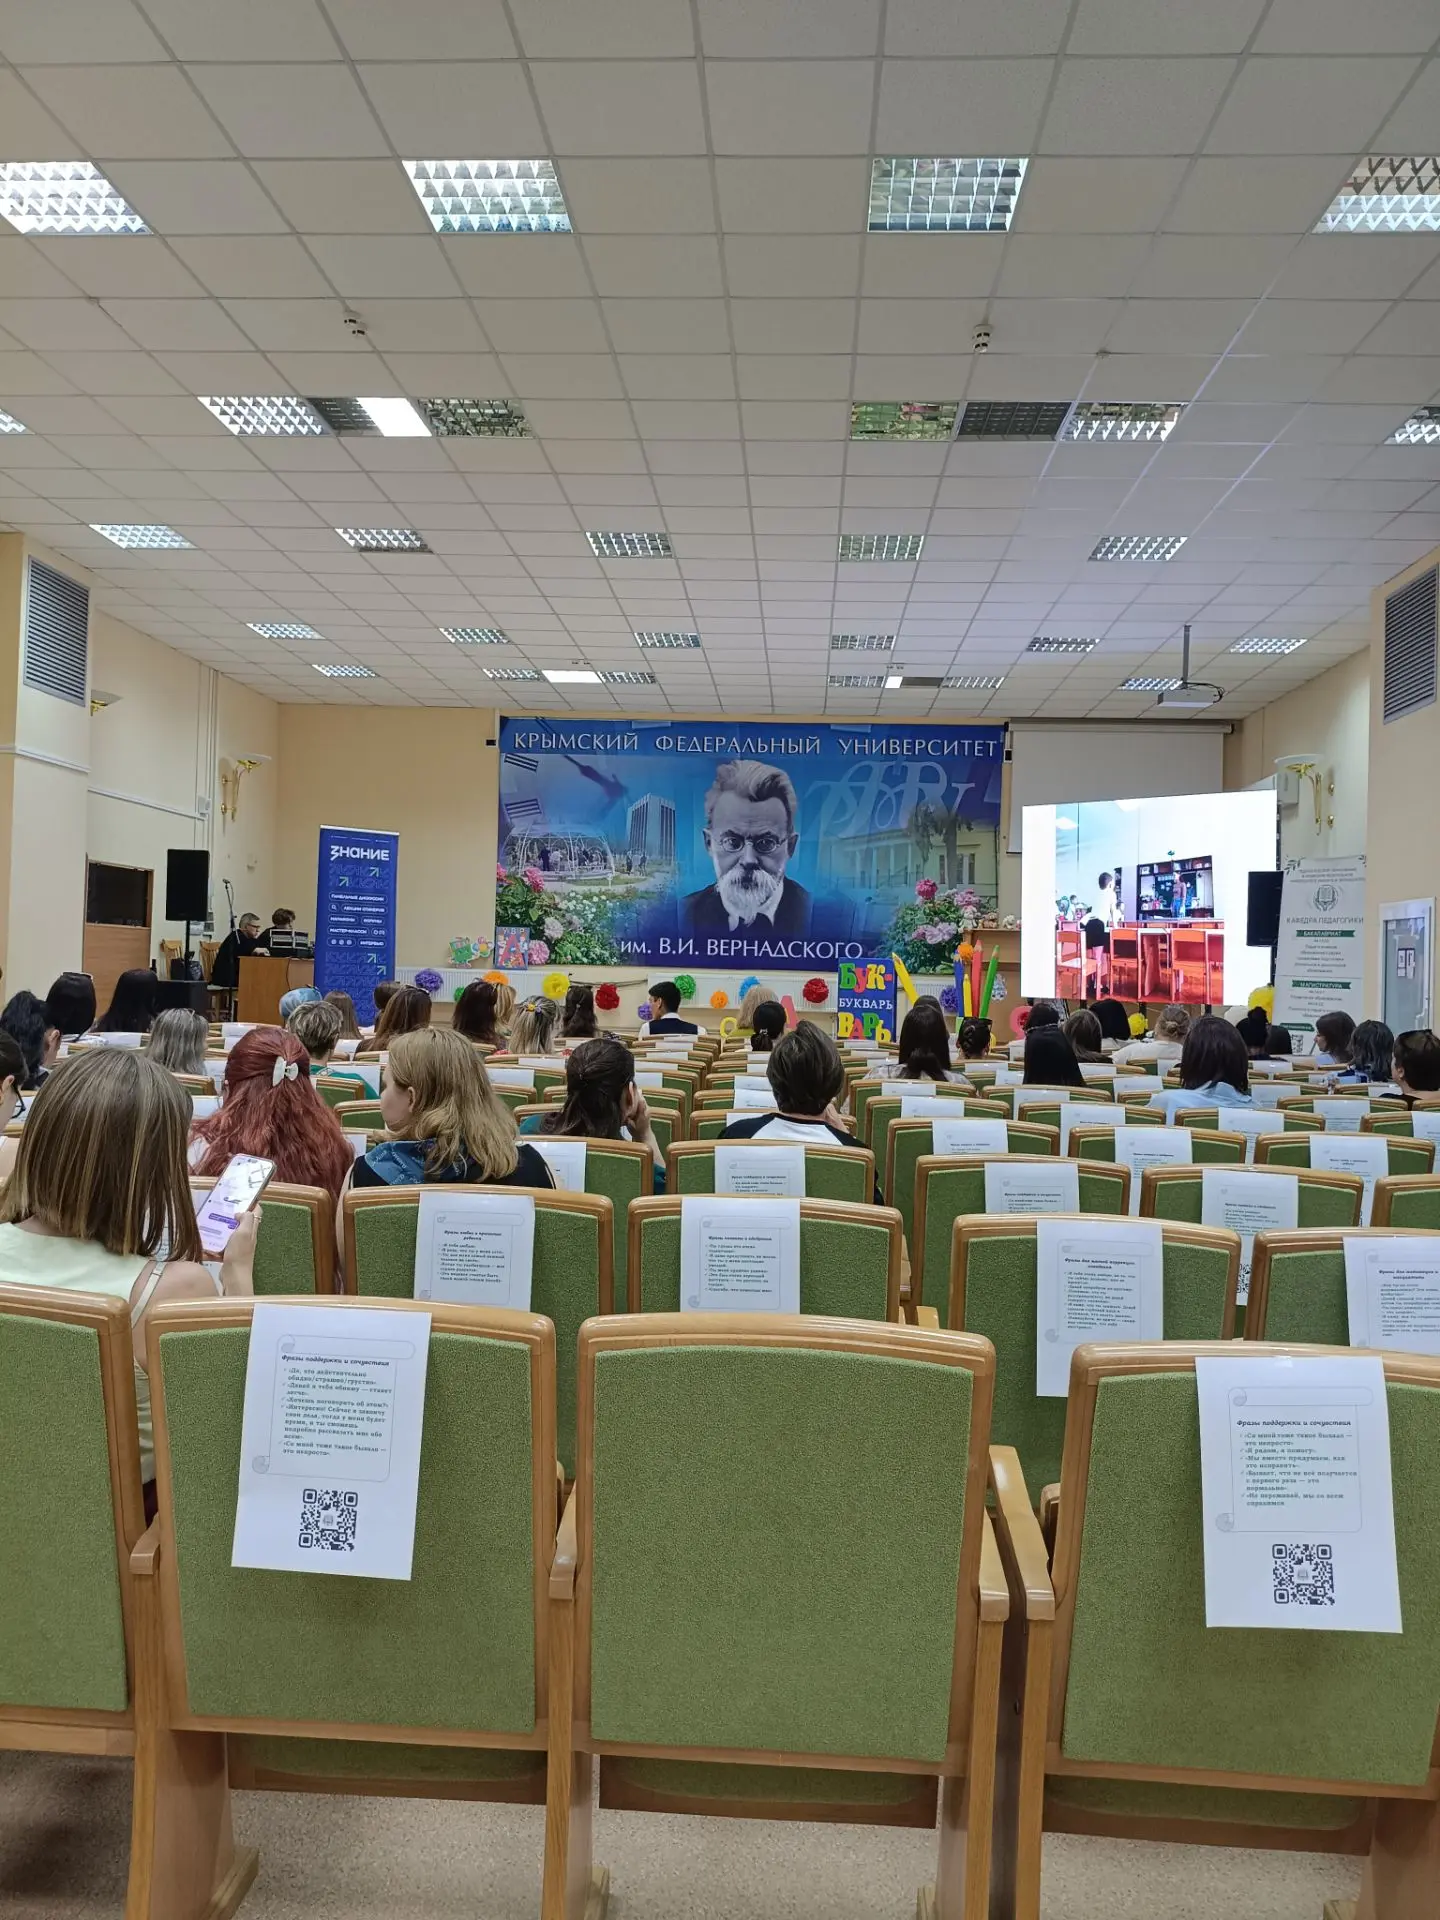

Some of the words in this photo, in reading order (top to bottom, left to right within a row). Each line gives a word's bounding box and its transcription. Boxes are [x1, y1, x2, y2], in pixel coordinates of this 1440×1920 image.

[515, 732, 638, 751] КРЫМСКИЙ
[655, 735, 821, 755] ФЕДЕРАЛЬНЫЙ
[838, 738, 998, 757] УНИВЕРСИТЕТ
[330, 845, 390, 861] ЗНАНИЕ
[621, 941, 651, 954] им.
[659, 937, 699, 955] В.И.
[707, 938, 863, 959] ВЕРНАДСКОГО
[838, 997, 894, 1010] БУКВАРЬ
[281, 1354, 303, 1362] Фразы
[305, 1355, 342, 1365] поддержки
